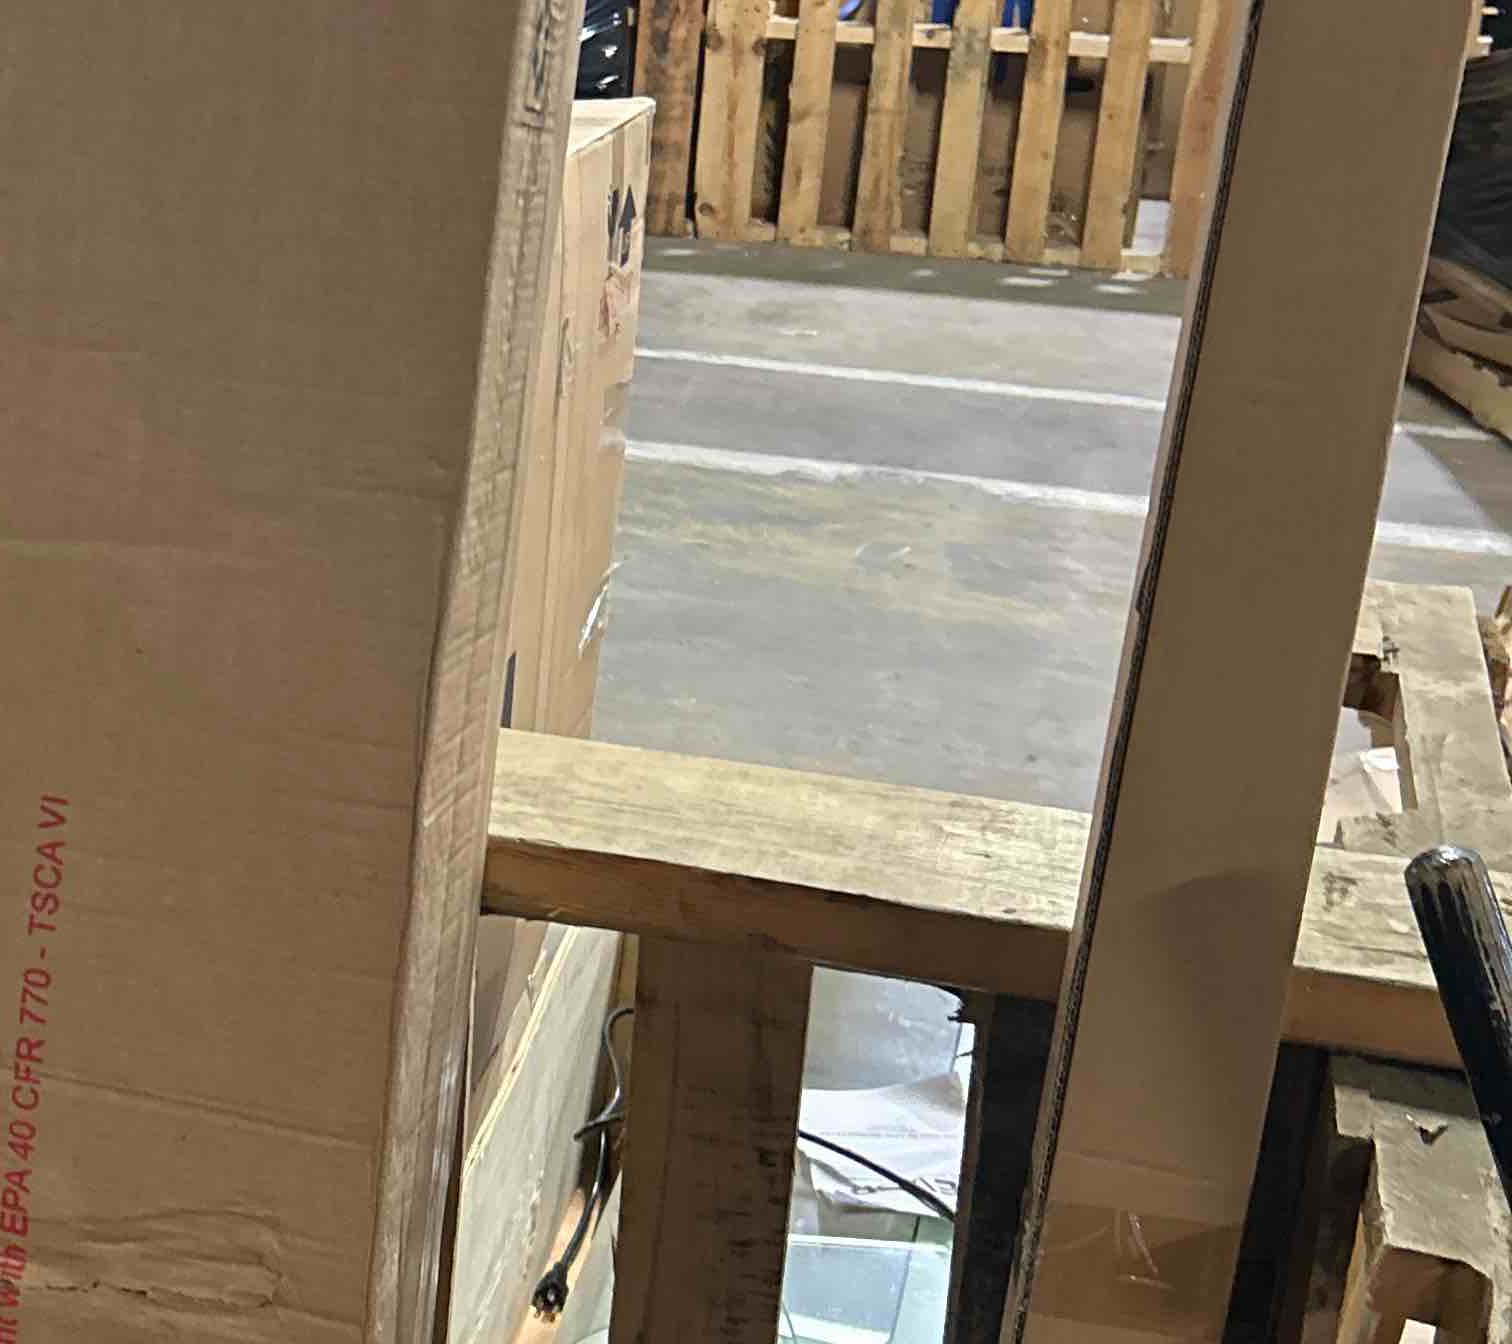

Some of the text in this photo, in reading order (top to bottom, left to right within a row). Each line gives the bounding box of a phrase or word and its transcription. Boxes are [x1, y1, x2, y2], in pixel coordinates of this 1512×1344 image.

[38, 794, 70, 830] VI
[28, 840, 68, 936] TSCA
[20, 968, 51, 1025] 770
[12, 1037, 45, 1110] CFR
[8, 1119, 37, 1160] 40
[0, 1168, 33, 1235] EPA
